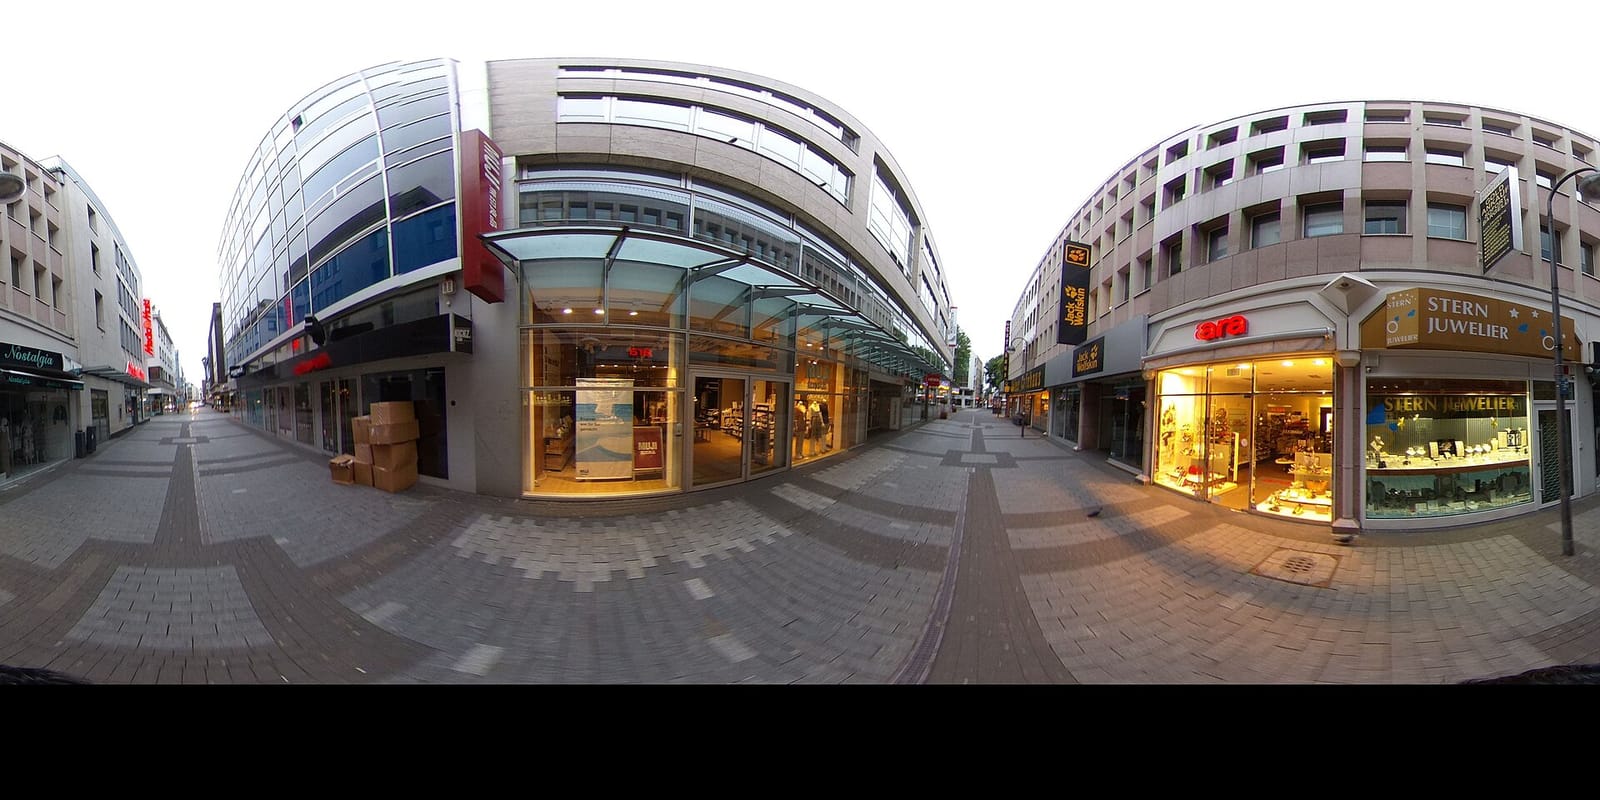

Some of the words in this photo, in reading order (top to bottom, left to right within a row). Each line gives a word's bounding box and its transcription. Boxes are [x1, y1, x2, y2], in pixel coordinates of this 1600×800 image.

[483, 141, 500, 191] MUJI
[1065, 302, 1075, 325] Jack
[1074, 287, 1085, 326] Wolfskin
[1387, 298, 1412, 309] STERN
[1428, 297, 1488, 318] STERN
[1194, 314, 1248, 342] ara
[1387, 334, 1418, 344] JUWELIER
[1428, 317, 1509, 340] JUWELIER
[5, 344, 54, 368] Nostalgia
[1077, 350, 1089, 363] Jack
[1077, 359, 1098, 372] Wolfskin
[1385, 396, 1436, 412] STERN
[1442, 397, 1515, 412] JUWELIER
